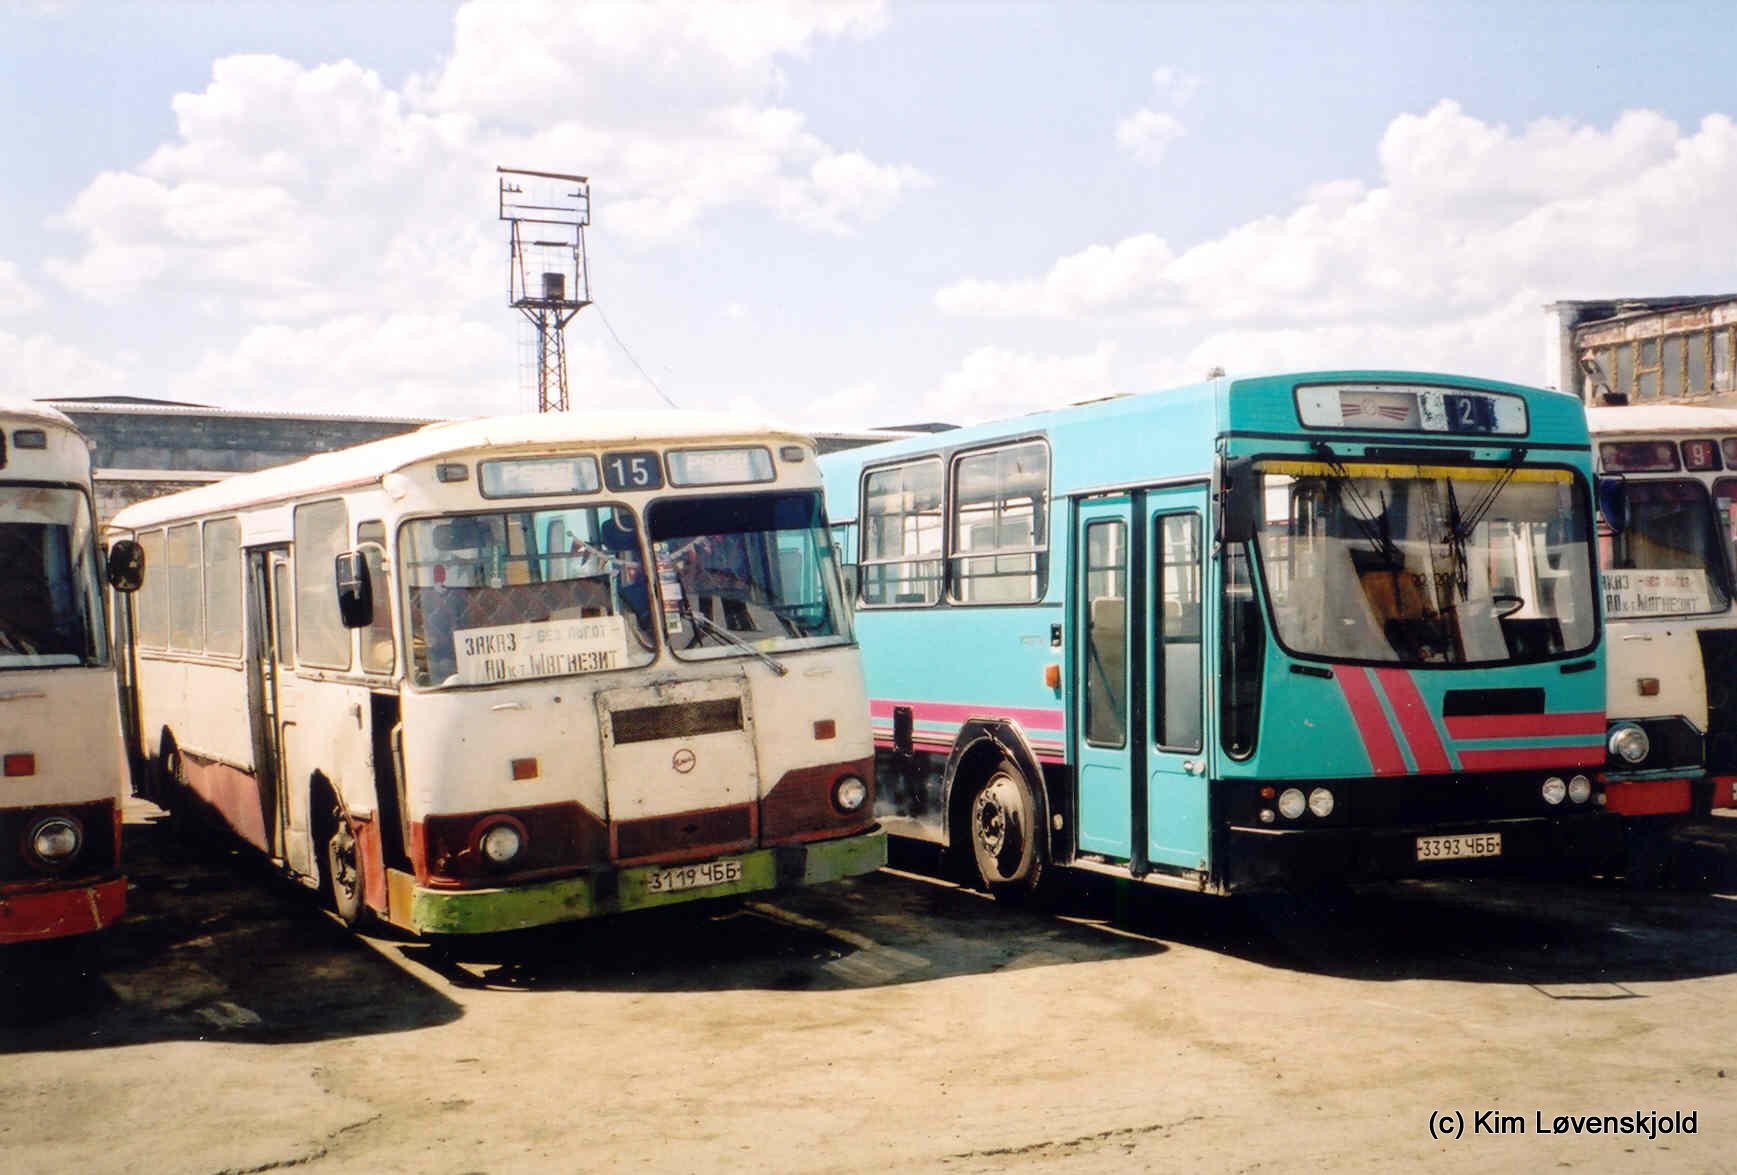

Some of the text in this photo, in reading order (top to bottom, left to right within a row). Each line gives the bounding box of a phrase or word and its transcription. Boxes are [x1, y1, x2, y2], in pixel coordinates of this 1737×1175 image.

[1459, 399, 1474, 424] 2
[611, 458, 649, 486] 15
[465, 633, 516, 656] ЗАКАЗ
[1423, 837, 1495, 856] 3393 ЧББ
[652, 863, 737, 889] 3119 ЧББ
